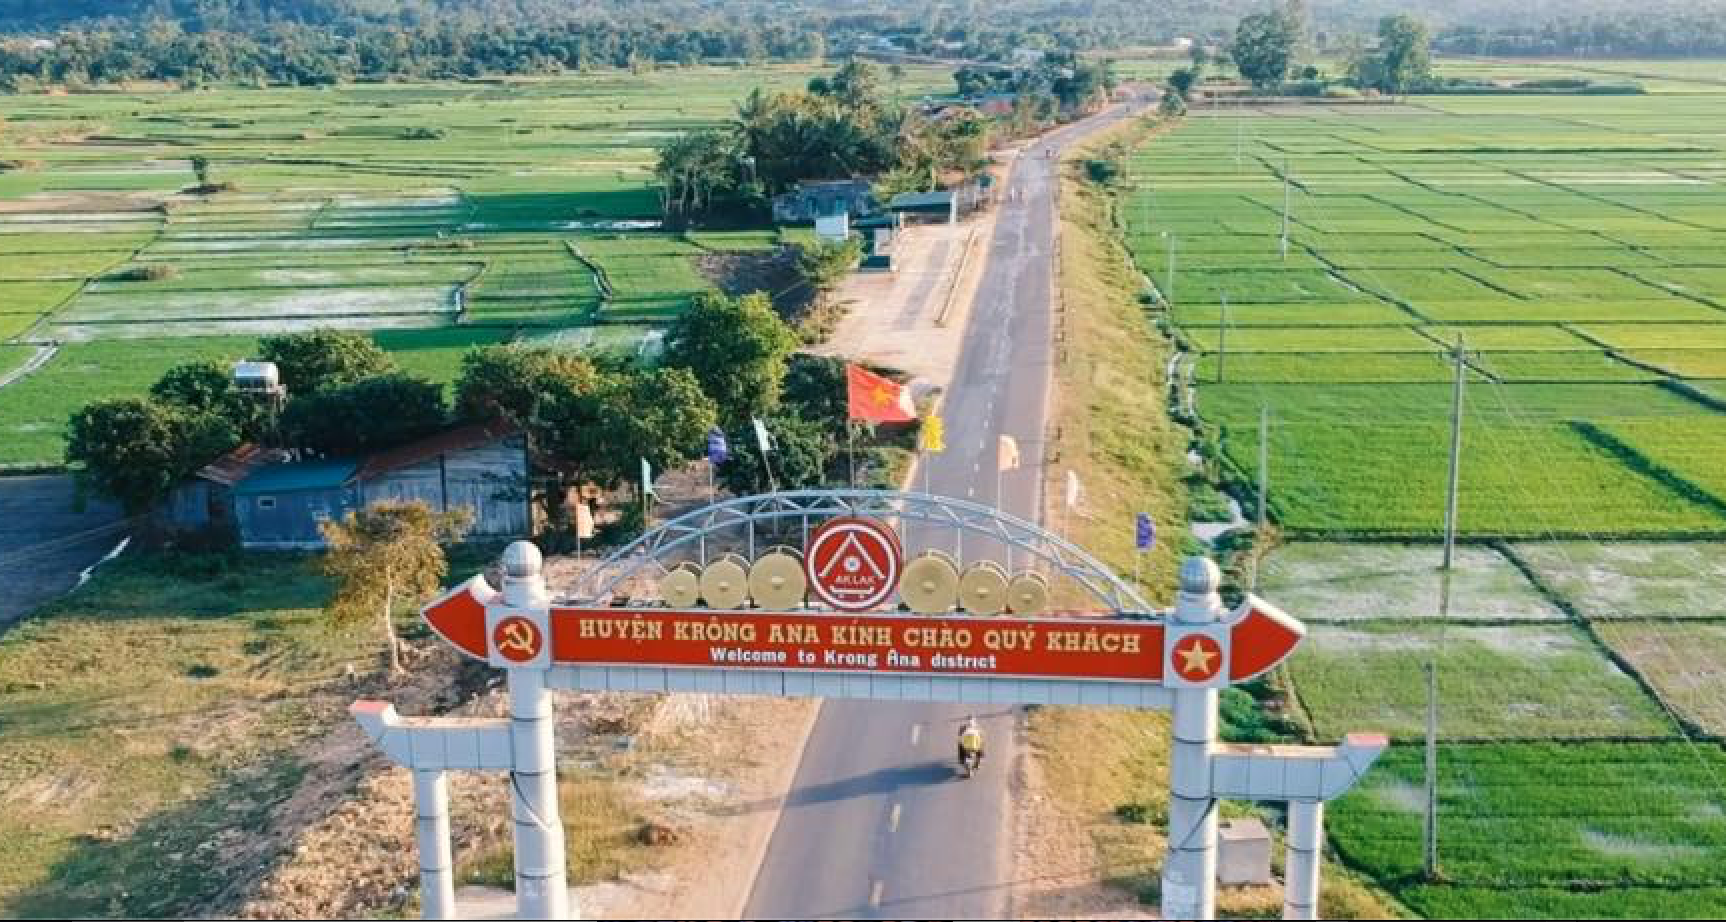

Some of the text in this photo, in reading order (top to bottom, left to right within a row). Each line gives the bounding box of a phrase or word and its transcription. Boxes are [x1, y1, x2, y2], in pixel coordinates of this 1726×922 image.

[580, 614, 1141, 654] HUYỆN KRÔNG ANA KÍNH CHÀO QUÝ KHÁCH
[710, 647, 787, 663] Welcome
[798, 649, 816, 664] to
[824, 649, 879, 667] Krong
[932, 652, 997, 669] district
